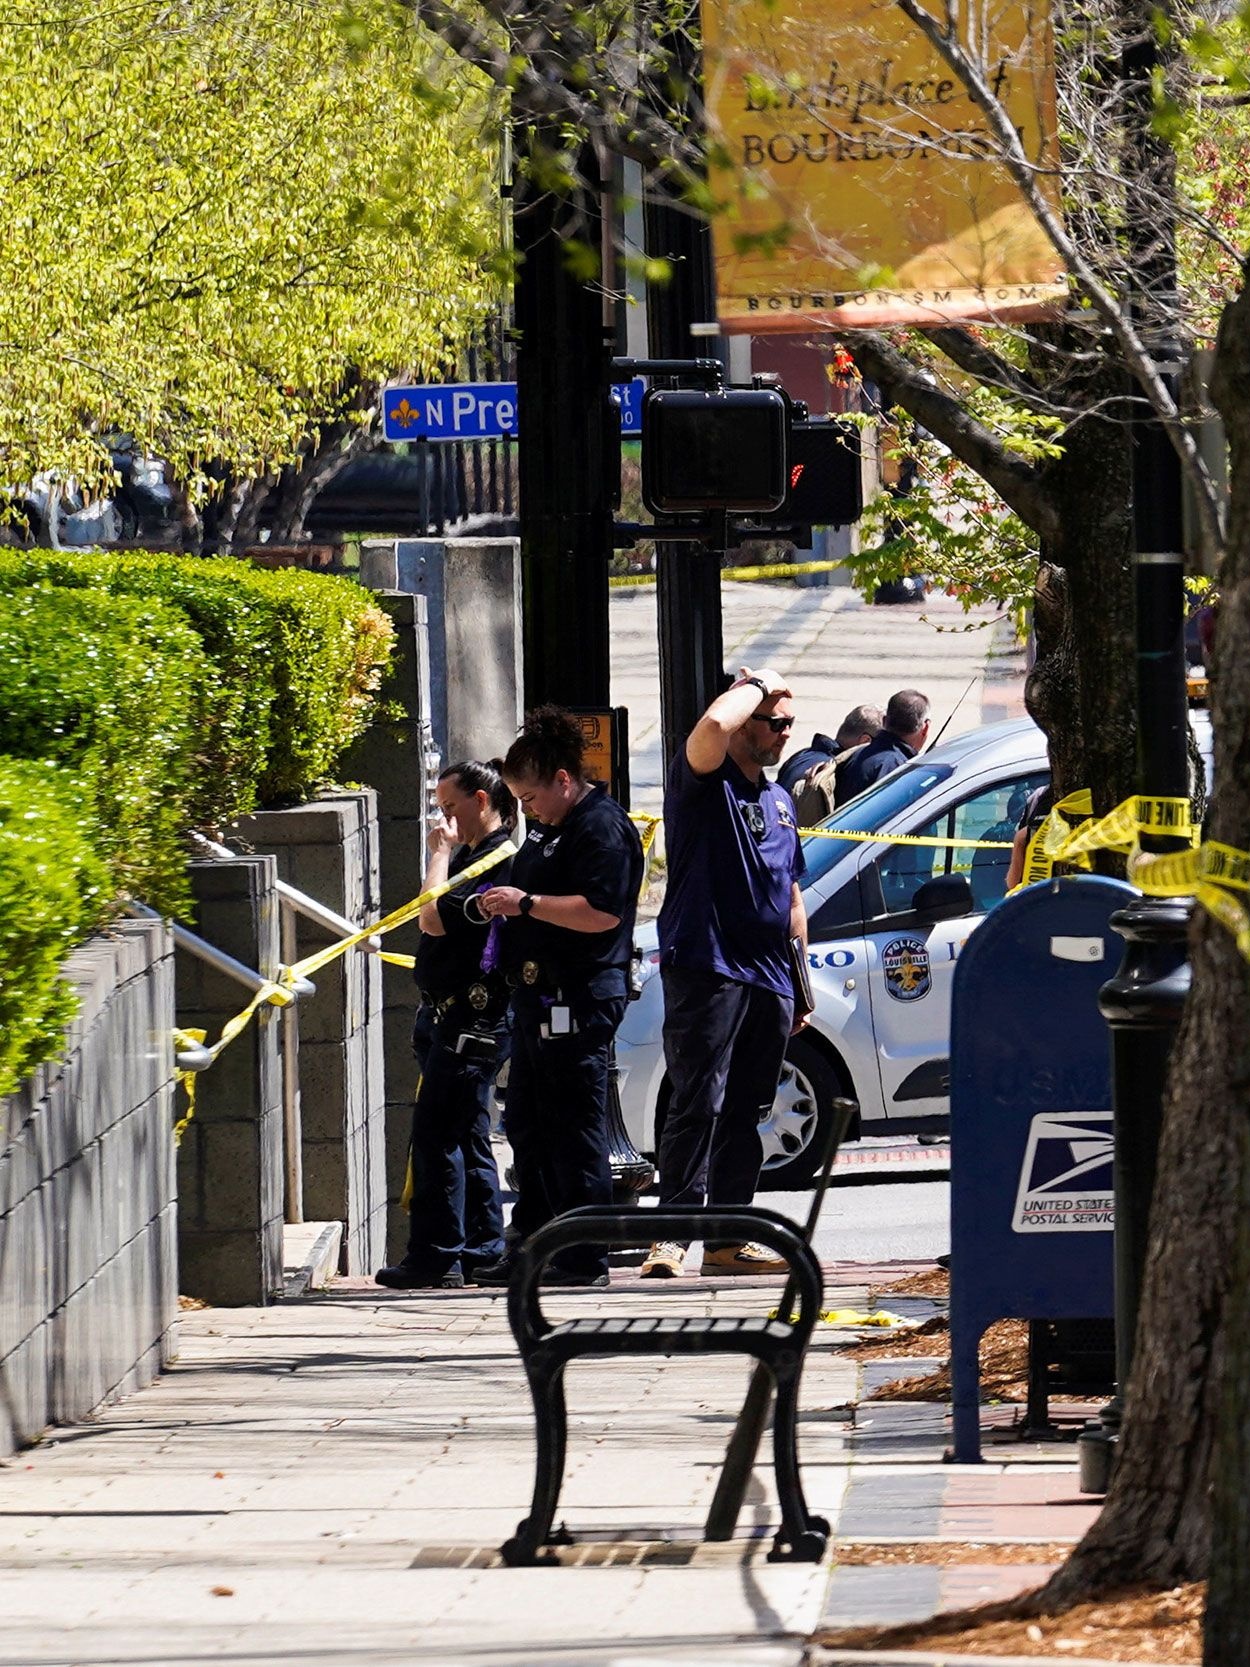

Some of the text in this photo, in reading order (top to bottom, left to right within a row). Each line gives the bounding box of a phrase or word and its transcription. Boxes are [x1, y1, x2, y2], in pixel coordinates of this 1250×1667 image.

[742, 59, 953, 123] Bhplace
[742, 126, 1025, 166] BOURBONIS
[426, 399, 444, 426] N
[453, 391, 518, 431] Pre
[887, 940, 924, 956] POLICE
[885, 955, 927, 967] LOUISVILLE
[1023, 1198, 1115, 1212] UNITED STATE
[1020, 1214, 1068, 1225] POSTAL
